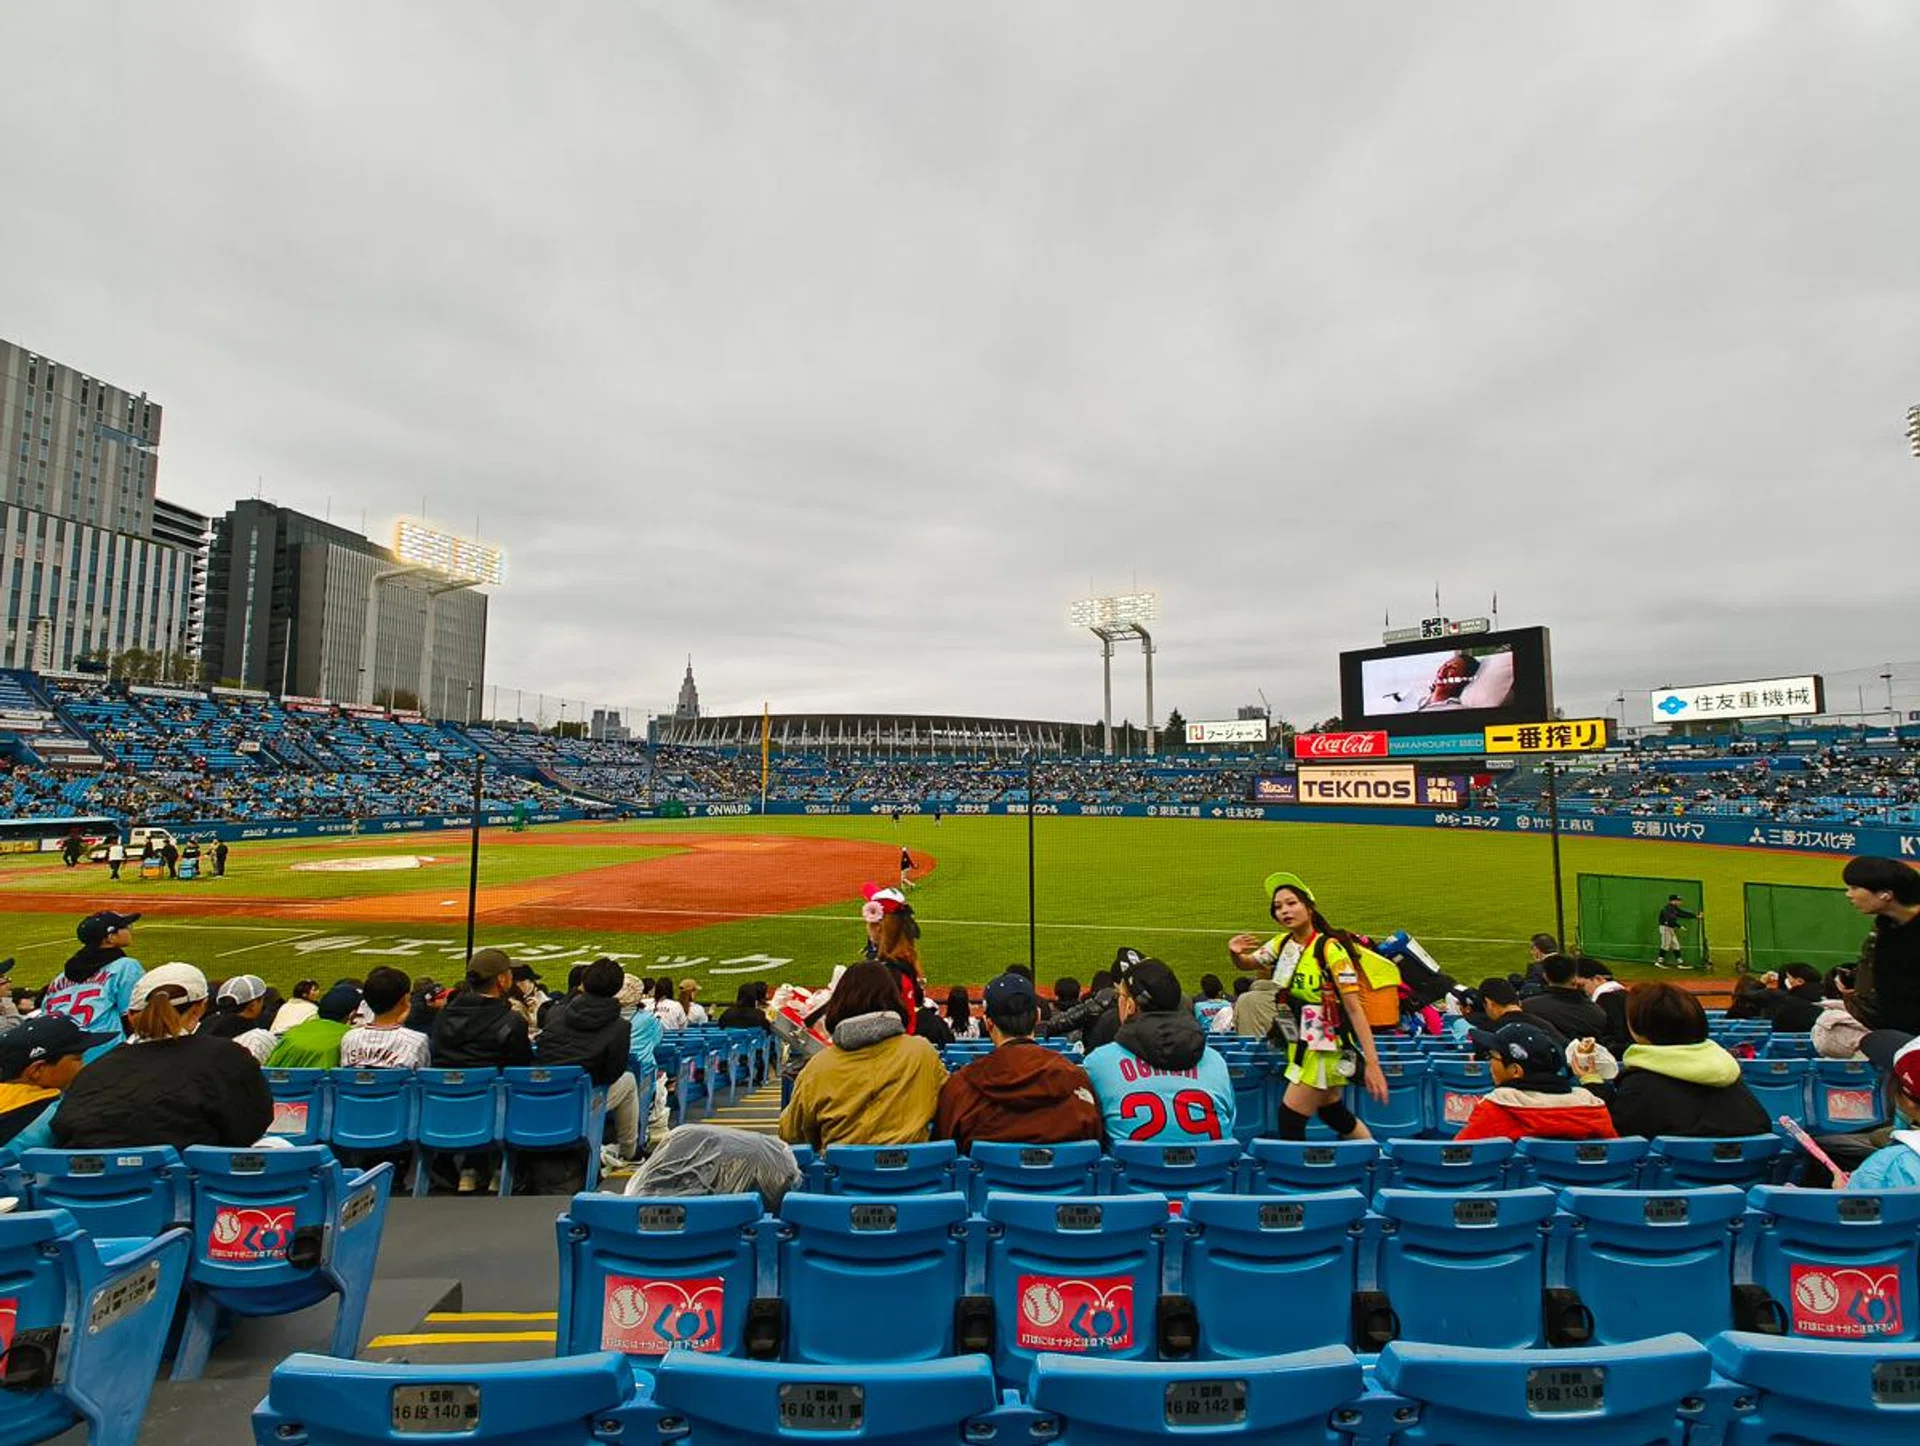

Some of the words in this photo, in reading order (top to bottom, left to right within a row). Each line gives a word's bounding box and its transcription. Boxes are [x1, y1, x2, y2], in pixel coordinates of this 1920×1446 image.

[1694, 686, 1811, 713] 住友重機械
[1459, 736, 1484, 748] BED
[1491, 722, 1598, 749] 一番搾り
[1302, 779, 1411, 799] TEKNOS
[1225, 807, 1265, 819] 住友化学
[1631, 821, 1706, 838] 安藤ハザマ
[1768, 829, 1856, 850] 三菱ガス化学
[45, 988, 103, 1026] 55
[1120, 1089, 1222, 1141] 29
